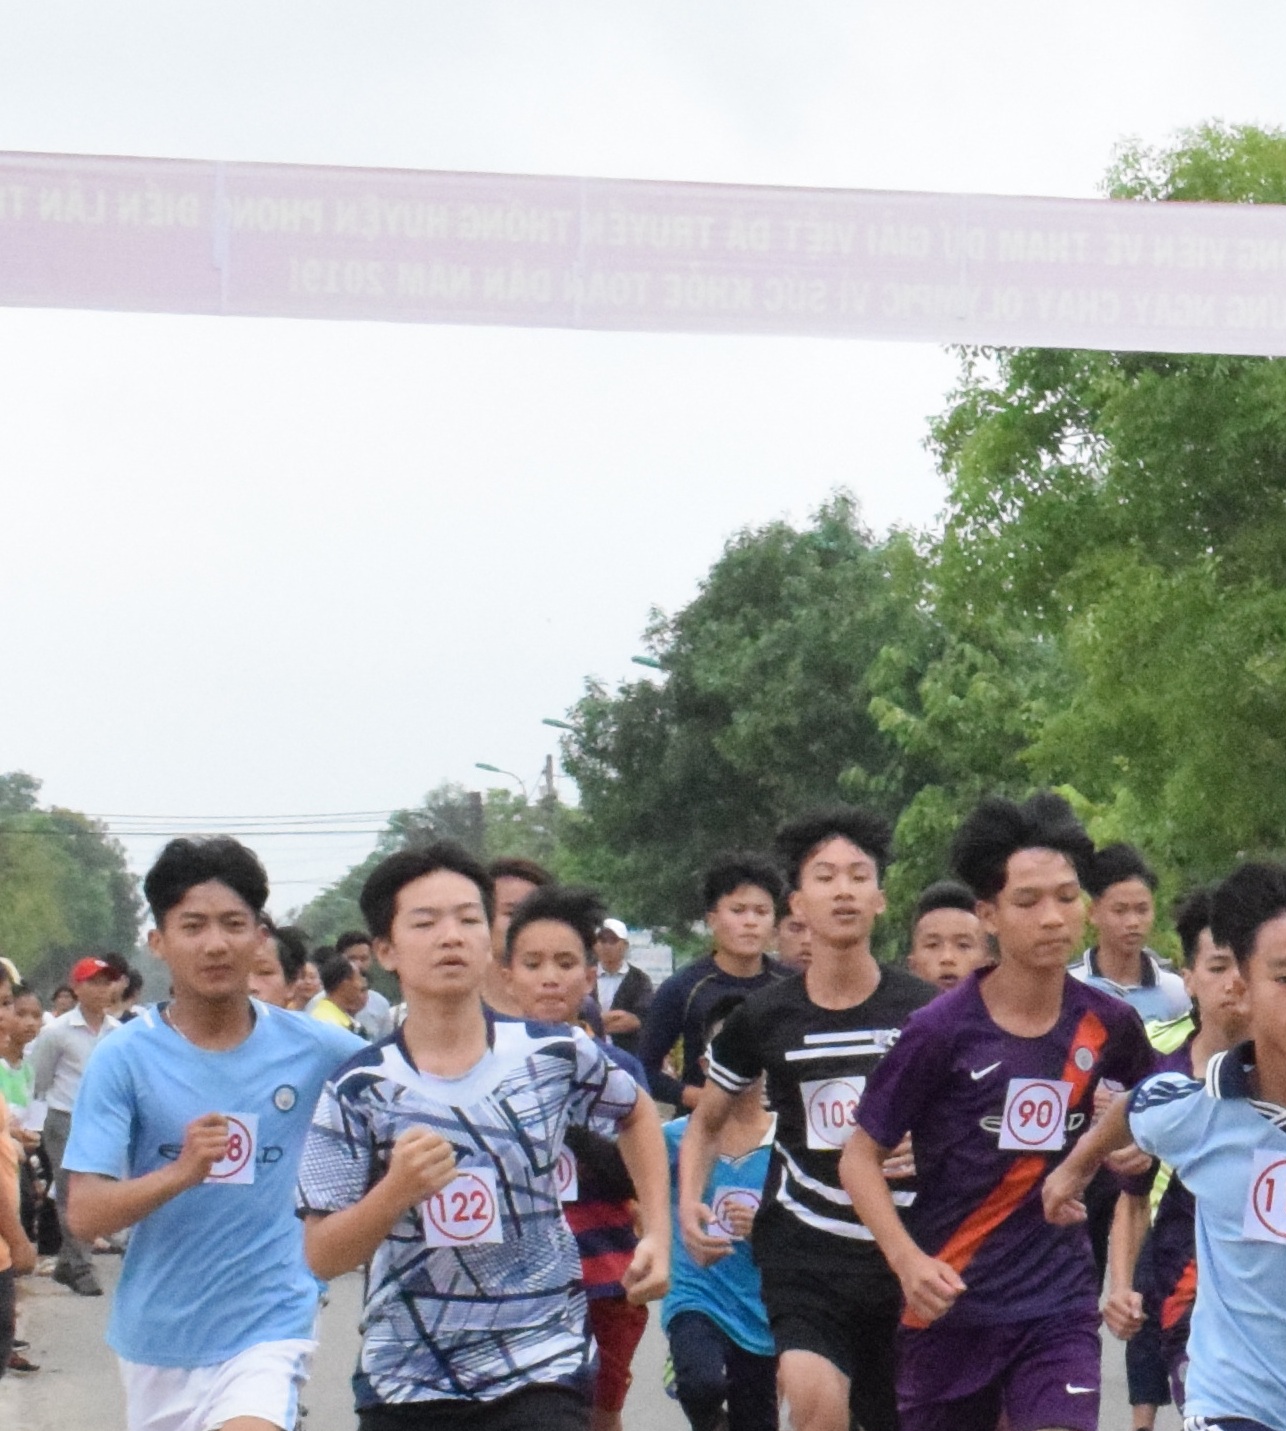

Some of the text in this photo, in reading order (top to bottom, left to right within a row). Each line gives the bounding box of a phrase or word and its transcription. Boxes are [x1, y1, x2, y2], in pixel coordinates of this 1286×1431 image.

[818, 1100, 860, 1128] 103
[1018, 1100, 1053, 1129] 90
[434, 1190, 489, 1223] 122
